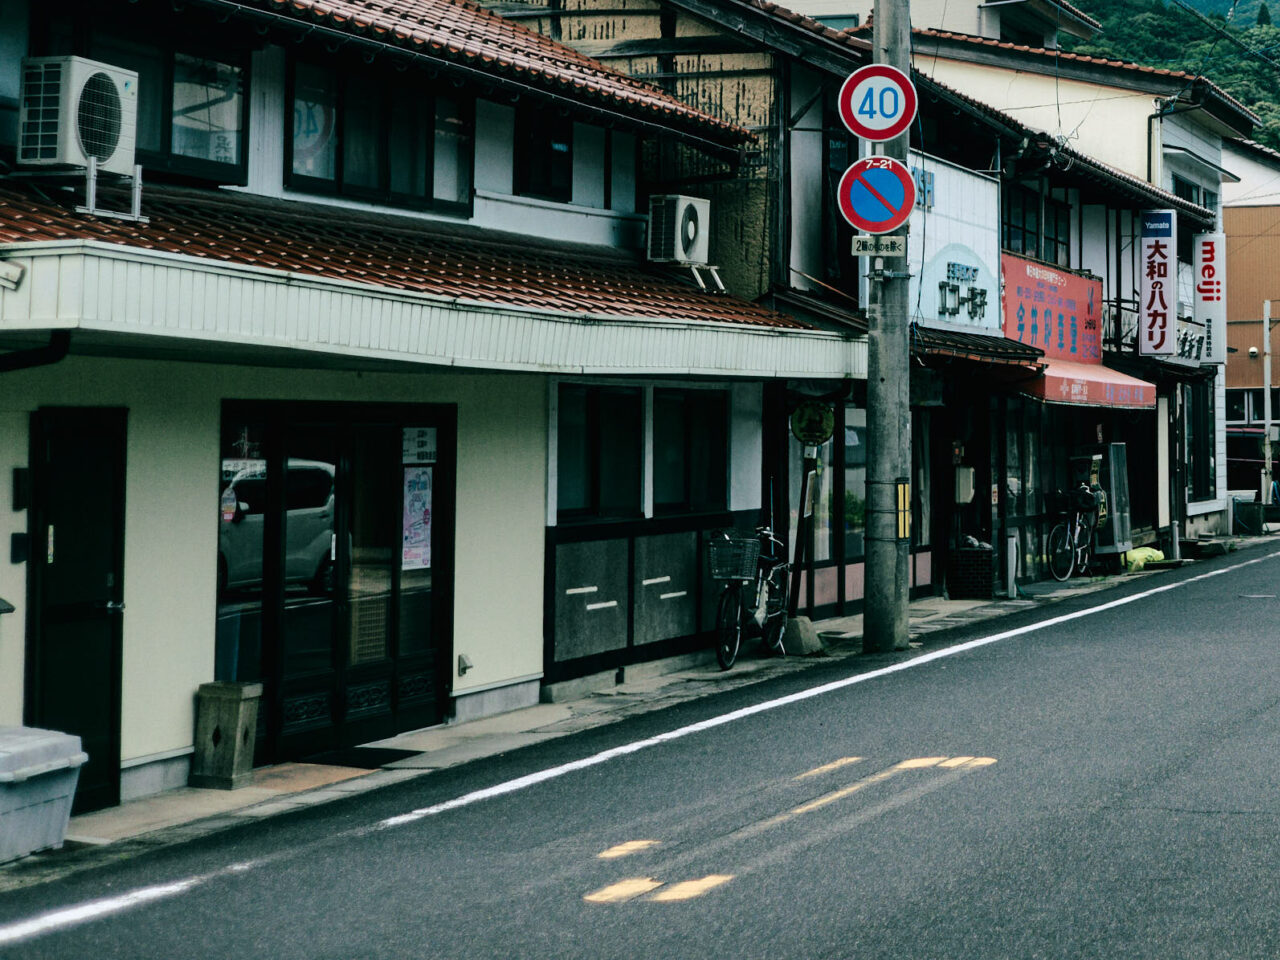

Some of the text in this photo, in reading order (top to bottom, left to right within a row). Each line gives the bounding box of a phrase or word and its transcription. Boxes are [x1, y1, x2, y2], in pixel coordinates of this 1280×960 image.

[858, 86, 899, 119] 40
[865, 160, 893, 169] 7-21
[1146, 239, 1168, 351] 大和のハカリ
[1197, 241, 1221, 302] meiji
